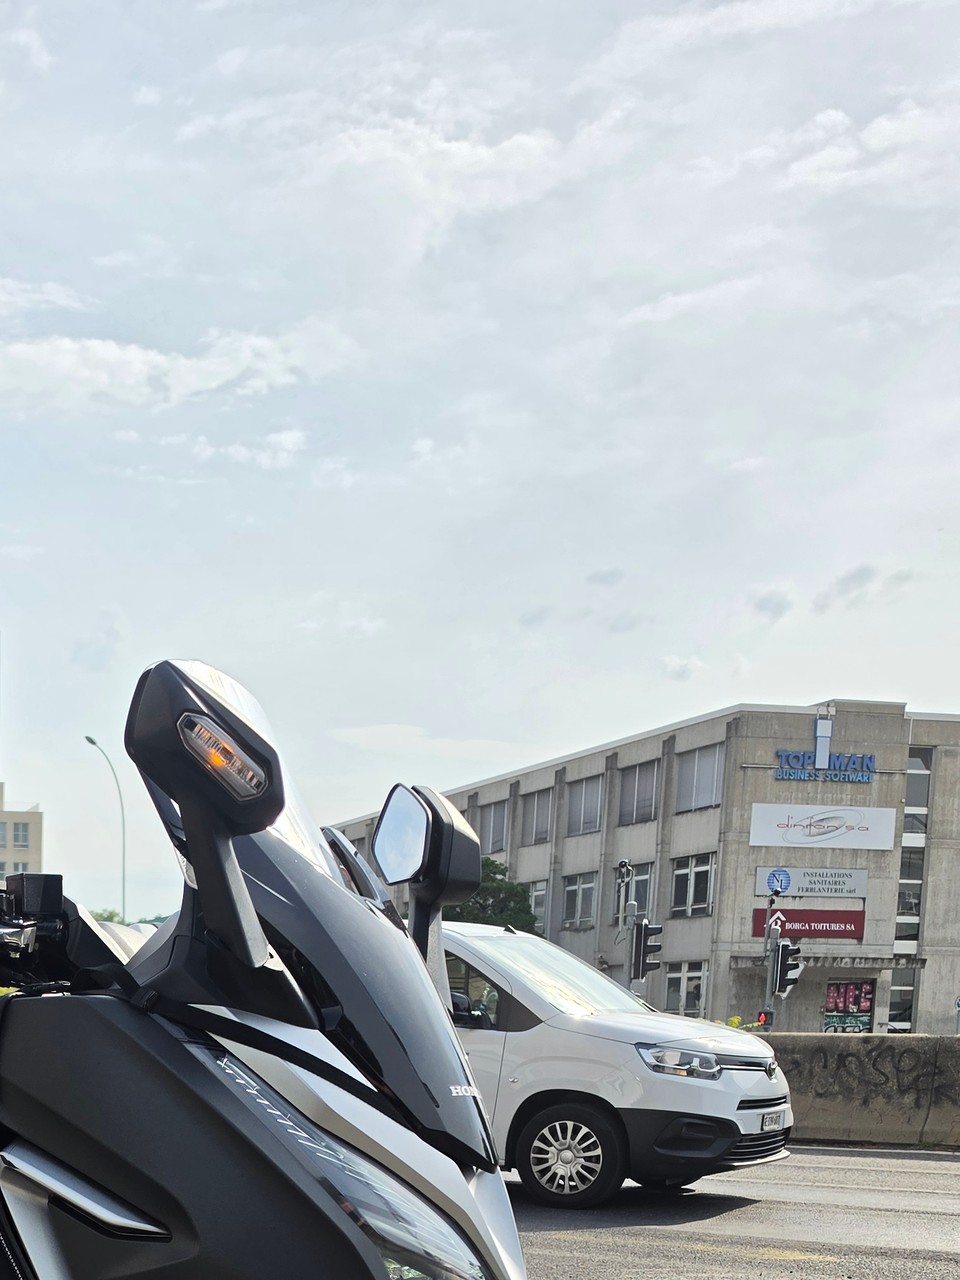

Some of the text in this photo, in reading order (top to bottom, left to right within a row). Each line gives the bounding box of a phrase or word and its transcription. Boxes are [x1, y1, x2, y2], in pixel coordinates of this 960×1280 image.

[777, 750, 875, 771] TOP MAN
[776, 768, 822, 781] BUSINESS
[803, 871, 853, 879] INSTALLATIONS
[797, 886, 845, 894] FERBLANTERIE
[785, 922, 855, 931] BORGA TOITURES SA
